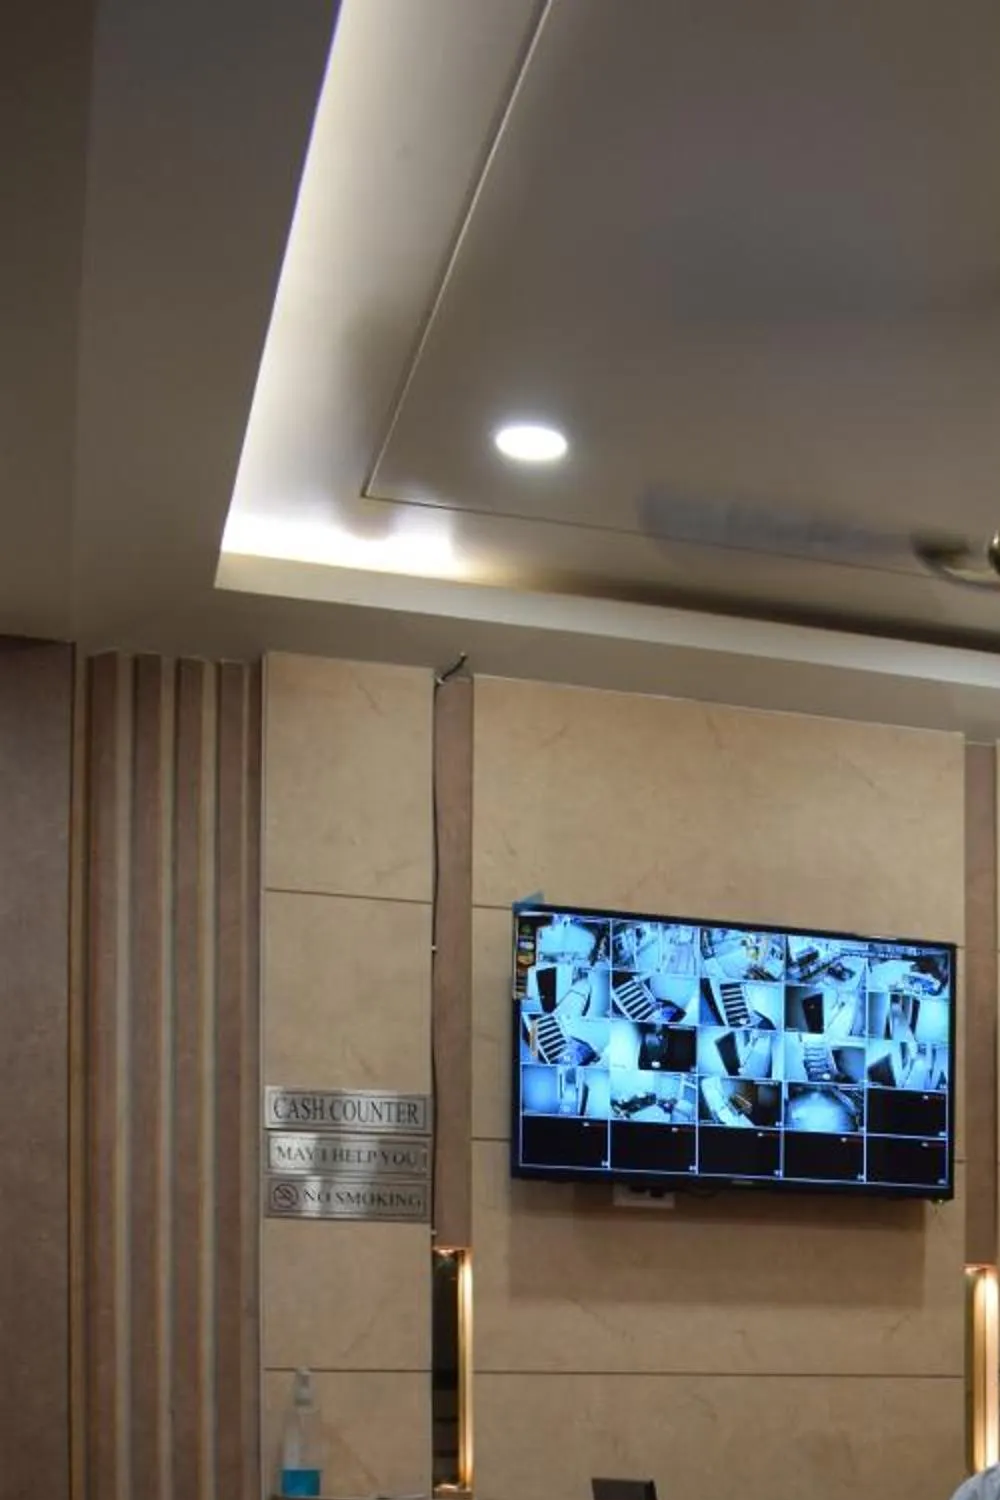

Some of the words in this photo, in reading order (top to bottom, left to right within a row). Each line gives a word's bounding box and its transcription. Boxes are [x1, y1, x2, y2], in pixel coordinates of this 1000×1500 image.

[273, 1096, 324, 1121] CASH
[329, 1098, 419, 1124] COUNTER
[276, 1145, 315, 1161] MAY
[332, 1147, 377, 1163] HELP
[379, 1150, 417, 1166] YOU
[303, 1188, 331, 1203] NO
[335, 1190, 422, 1208] SMOKING
